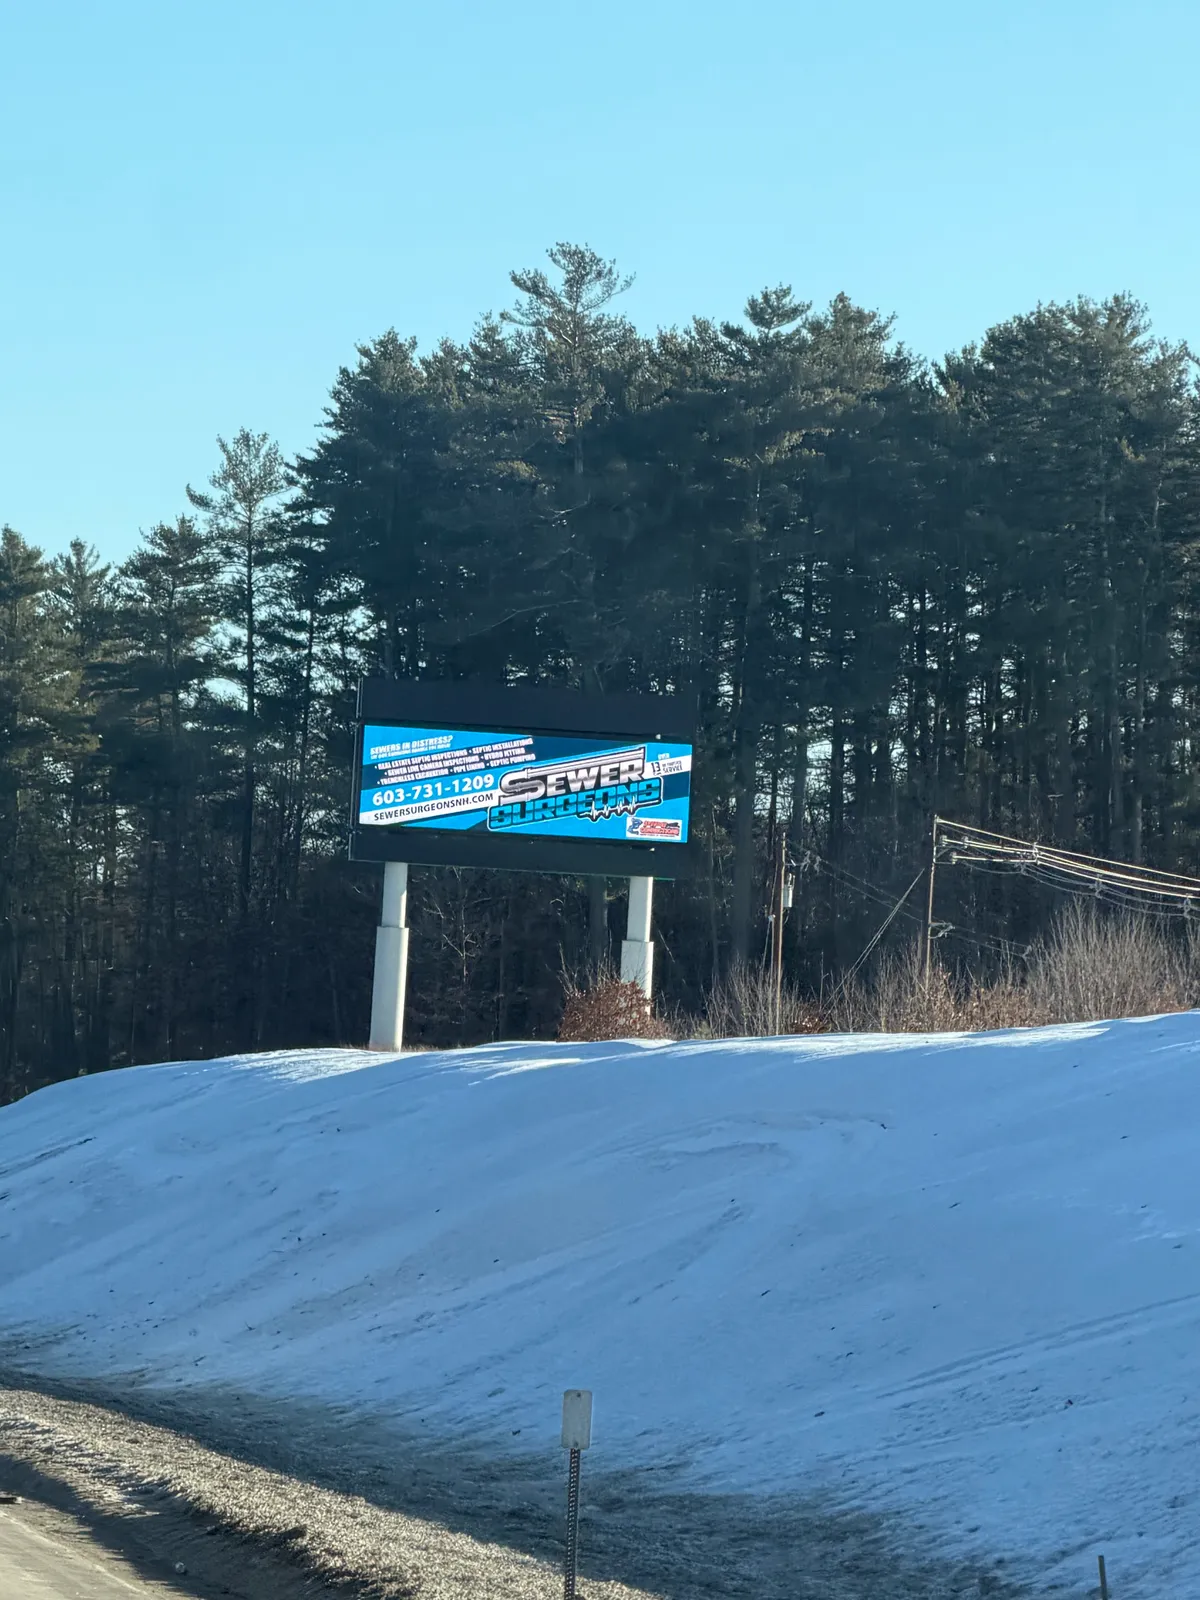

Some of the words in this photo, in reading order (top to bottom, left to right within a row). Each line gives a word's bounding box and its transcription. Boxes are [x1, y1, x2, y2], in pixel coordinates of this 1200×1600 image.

[370, 743, 401, 755] SEWERS
[402, 742, 410, 750] IN
[412, 735, 453, 749] DISTRESS?
[411, 755, 430, 764] SEPTIC
[431, 749, 468, 761] INSPECTIONS
[472, 745, 492, 754] SEPTIC
[492, 738, 533, 751] INSTALLATIONS
[420, 761, 443, 772] CAMERA
[443, 755, 479, 767] INSPECTIONS
[490, 758, 509, 767] SEPTIC
[372, 774, 494, 806] 603-731-1209
[500, 750, 645, 805] SEWER
[374, 793, 494, 821] SEWERSURGEONSNH.COM
[490, 778, 661, 829] SURGEONS
